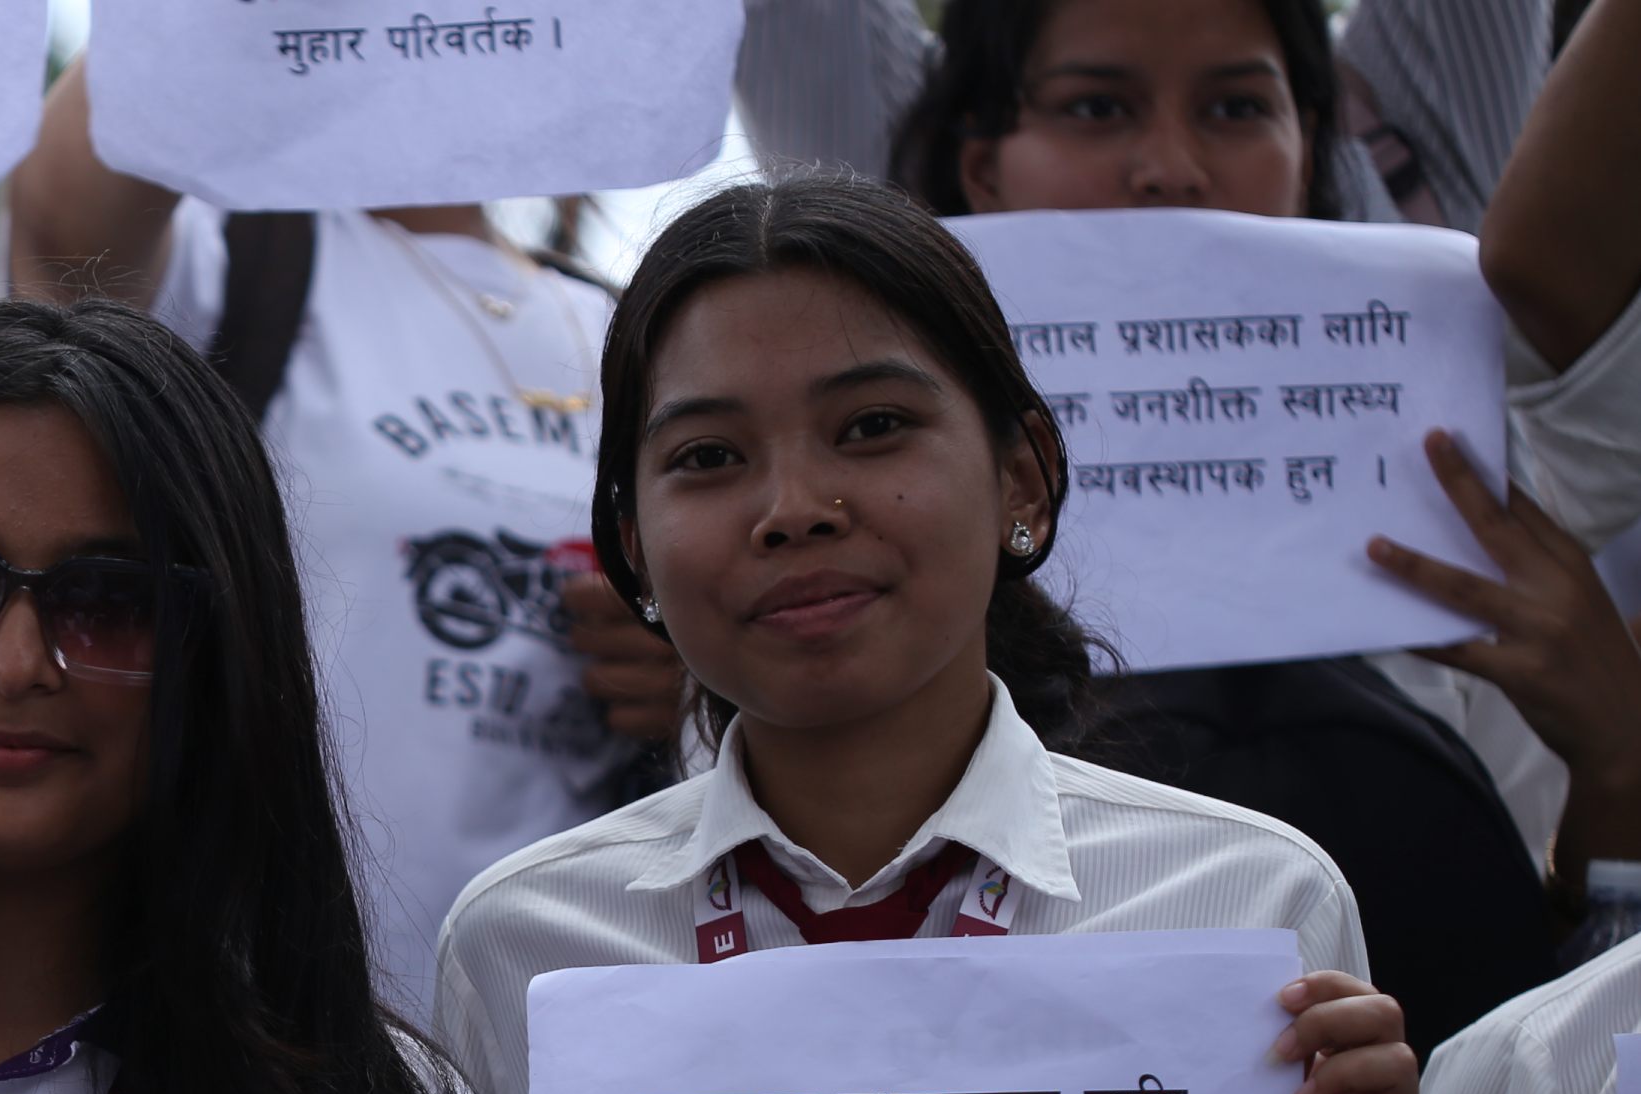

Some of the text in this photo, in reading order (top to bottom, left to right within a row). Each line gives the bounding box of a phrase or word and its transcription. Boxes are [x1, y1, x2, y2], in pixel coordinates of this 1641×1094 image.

[272, 27, 367, 77] मुहार
[385, 6, 534, 59] परिवर्तक
[1117, 313, 1303, 353] प्रशासकका
[1322, 299, 1412, 346] लागि
[372, 389, 584, 459] BASEM
[1279, 383, 1402, 418] स्वास्थ्य
[1073, 458, 1266, 497] व्यवस्थापक
[1284, 455, 1337, 503] हुन
